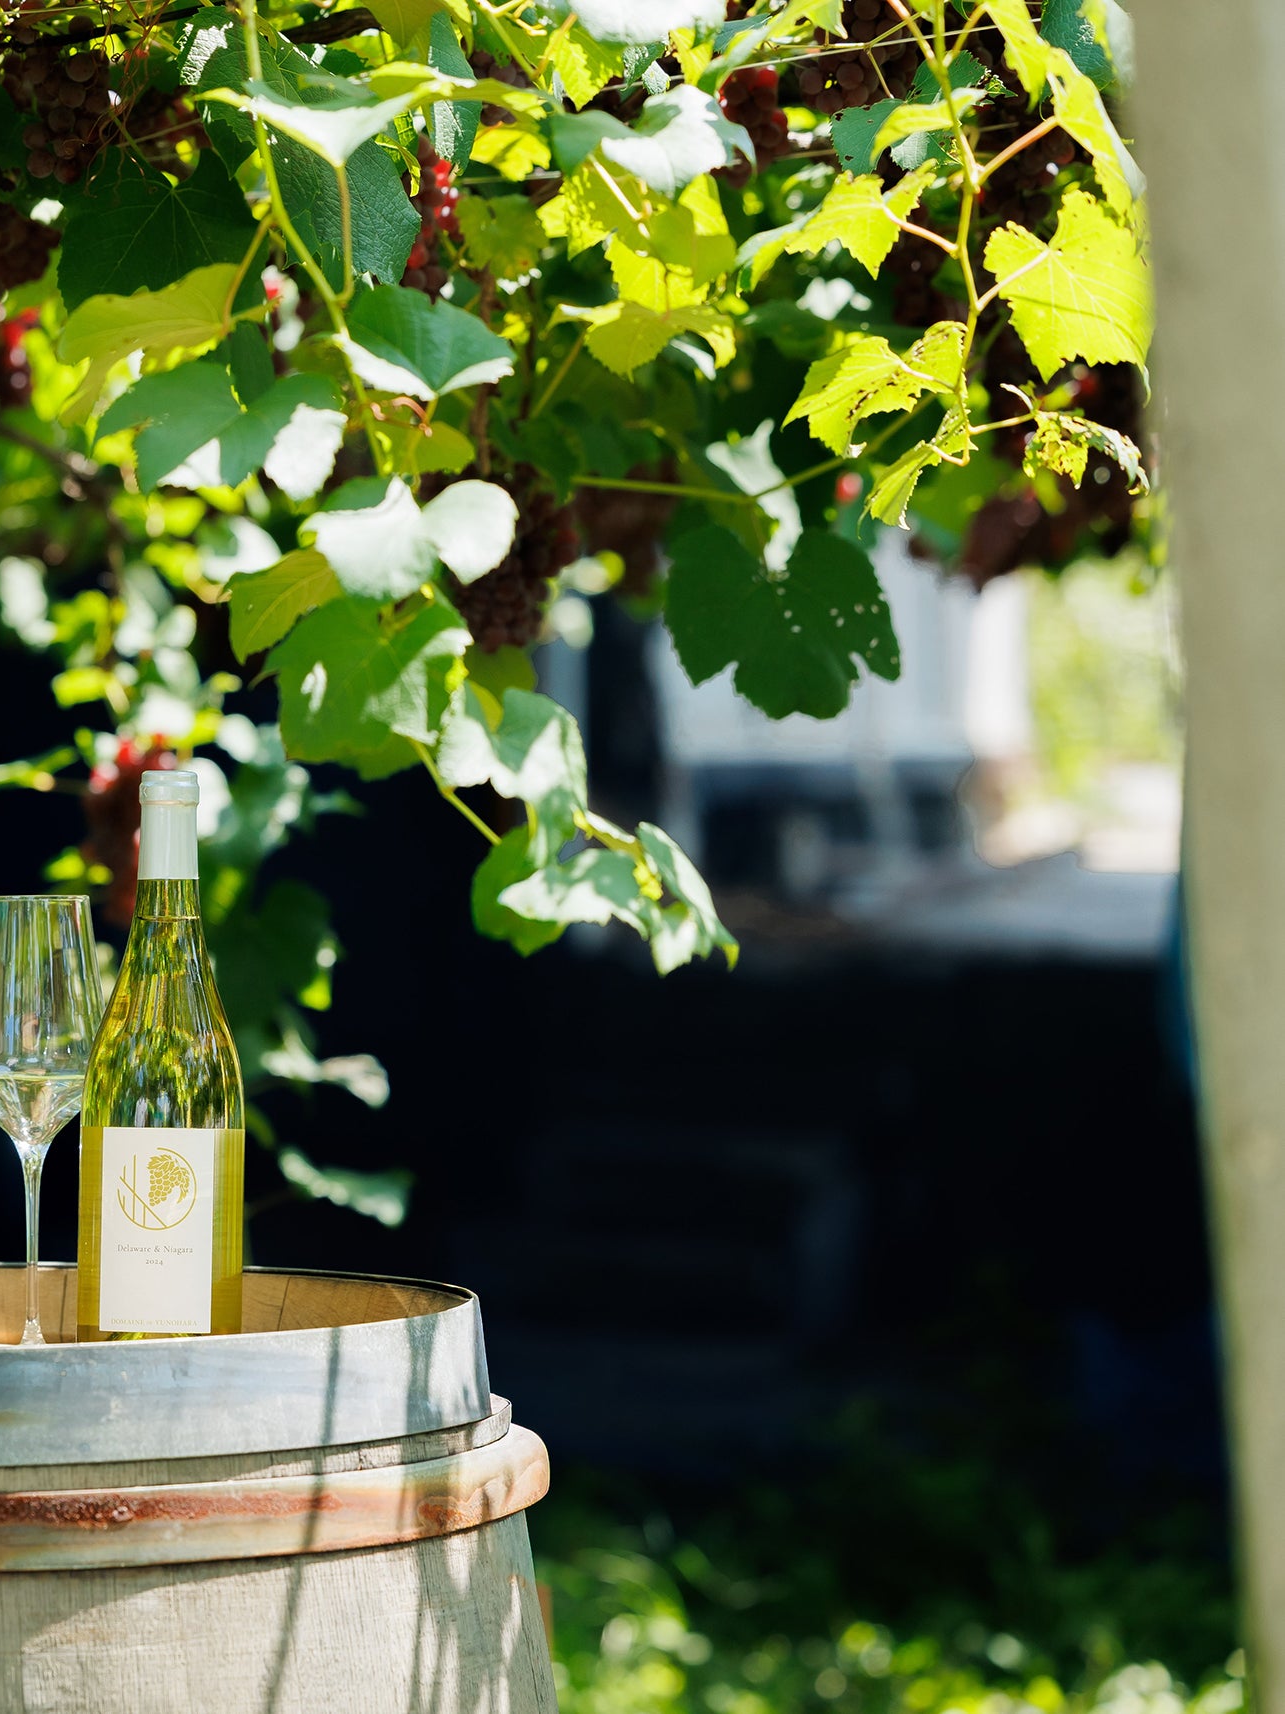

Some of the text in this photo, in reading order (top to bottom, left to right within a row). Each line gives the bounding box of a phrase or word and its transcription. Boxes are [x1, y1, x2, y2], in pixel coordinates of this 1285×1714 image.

[117, 1244, 194, 1255] Delaware & Niagara
[145, 1258, 164, 1266] 2024
[110, 1318, 145, 1326] DOMAINE
[154, 1319, 198, 1327] YUNOHARA
